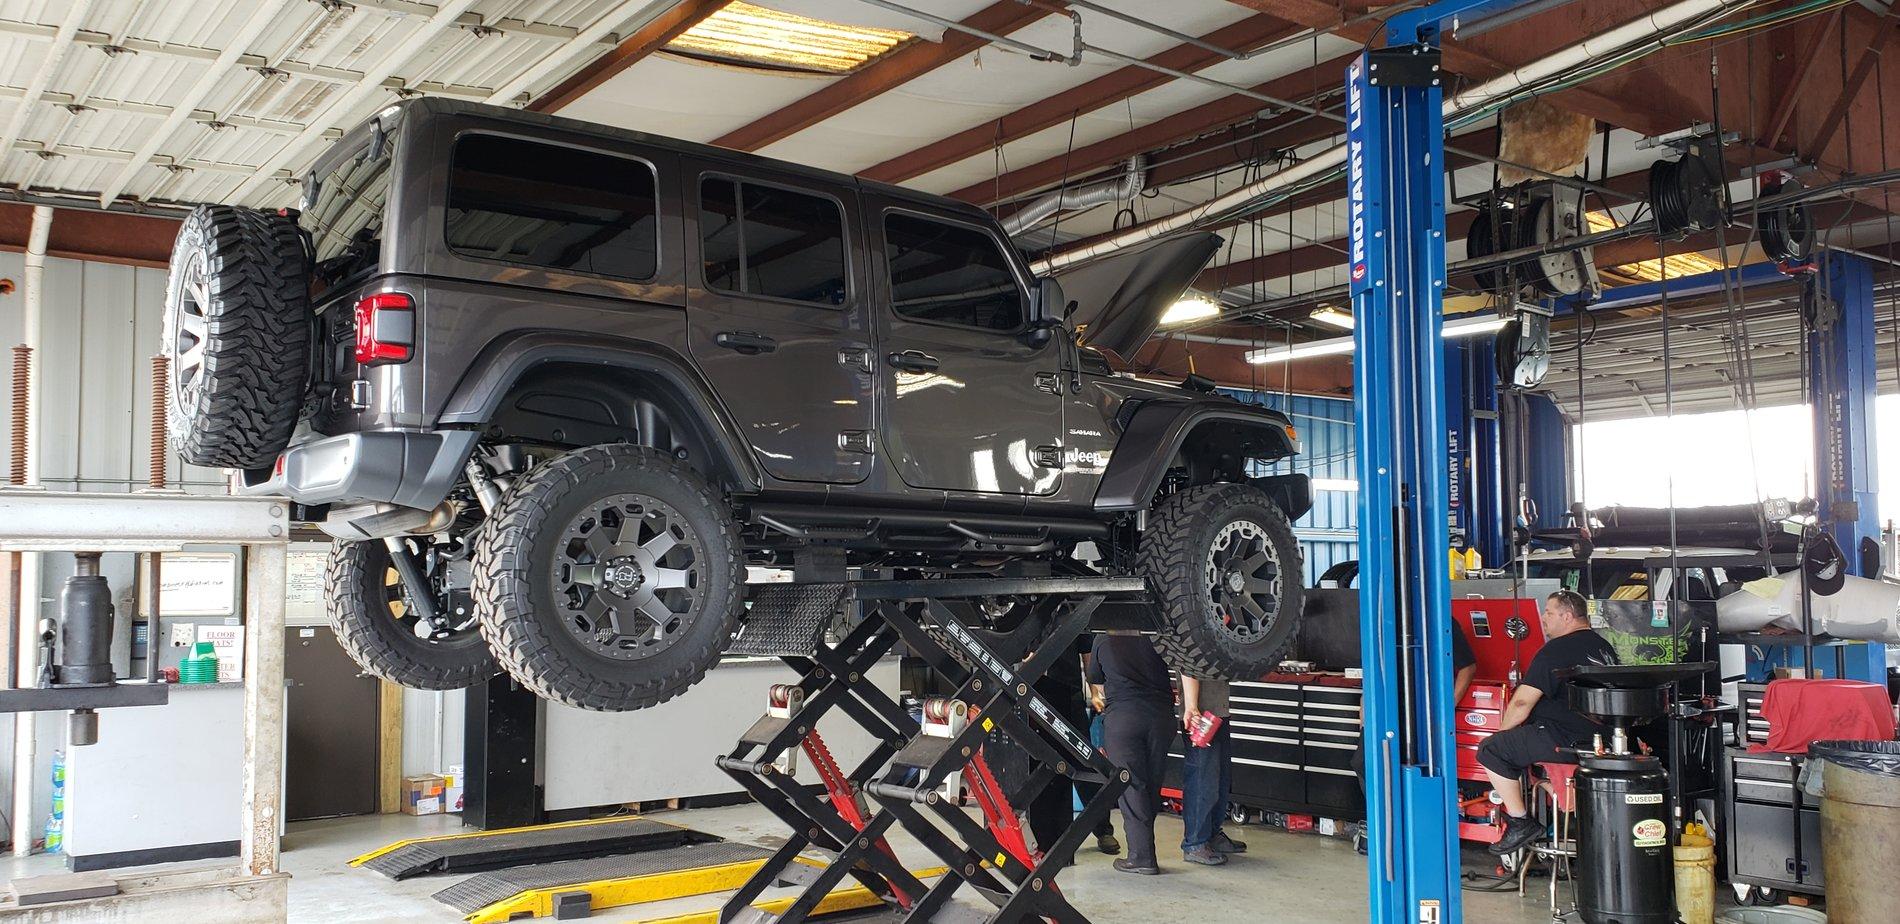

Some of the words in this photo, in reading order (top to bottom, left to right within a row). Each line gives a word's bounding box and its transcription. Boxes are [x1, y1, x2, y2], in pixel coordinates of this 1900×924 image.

[1350, 64, 1361, 132] LIFT
[1351, 140, 1364, 264] ROTARY
[1449, 430, 1458, 454] LIFT
[1449, 456, 1459, 501] ROTARY
[206, 631, 236, 639] FLOOR
[1608, 632, 1685, 646] MONSTE
